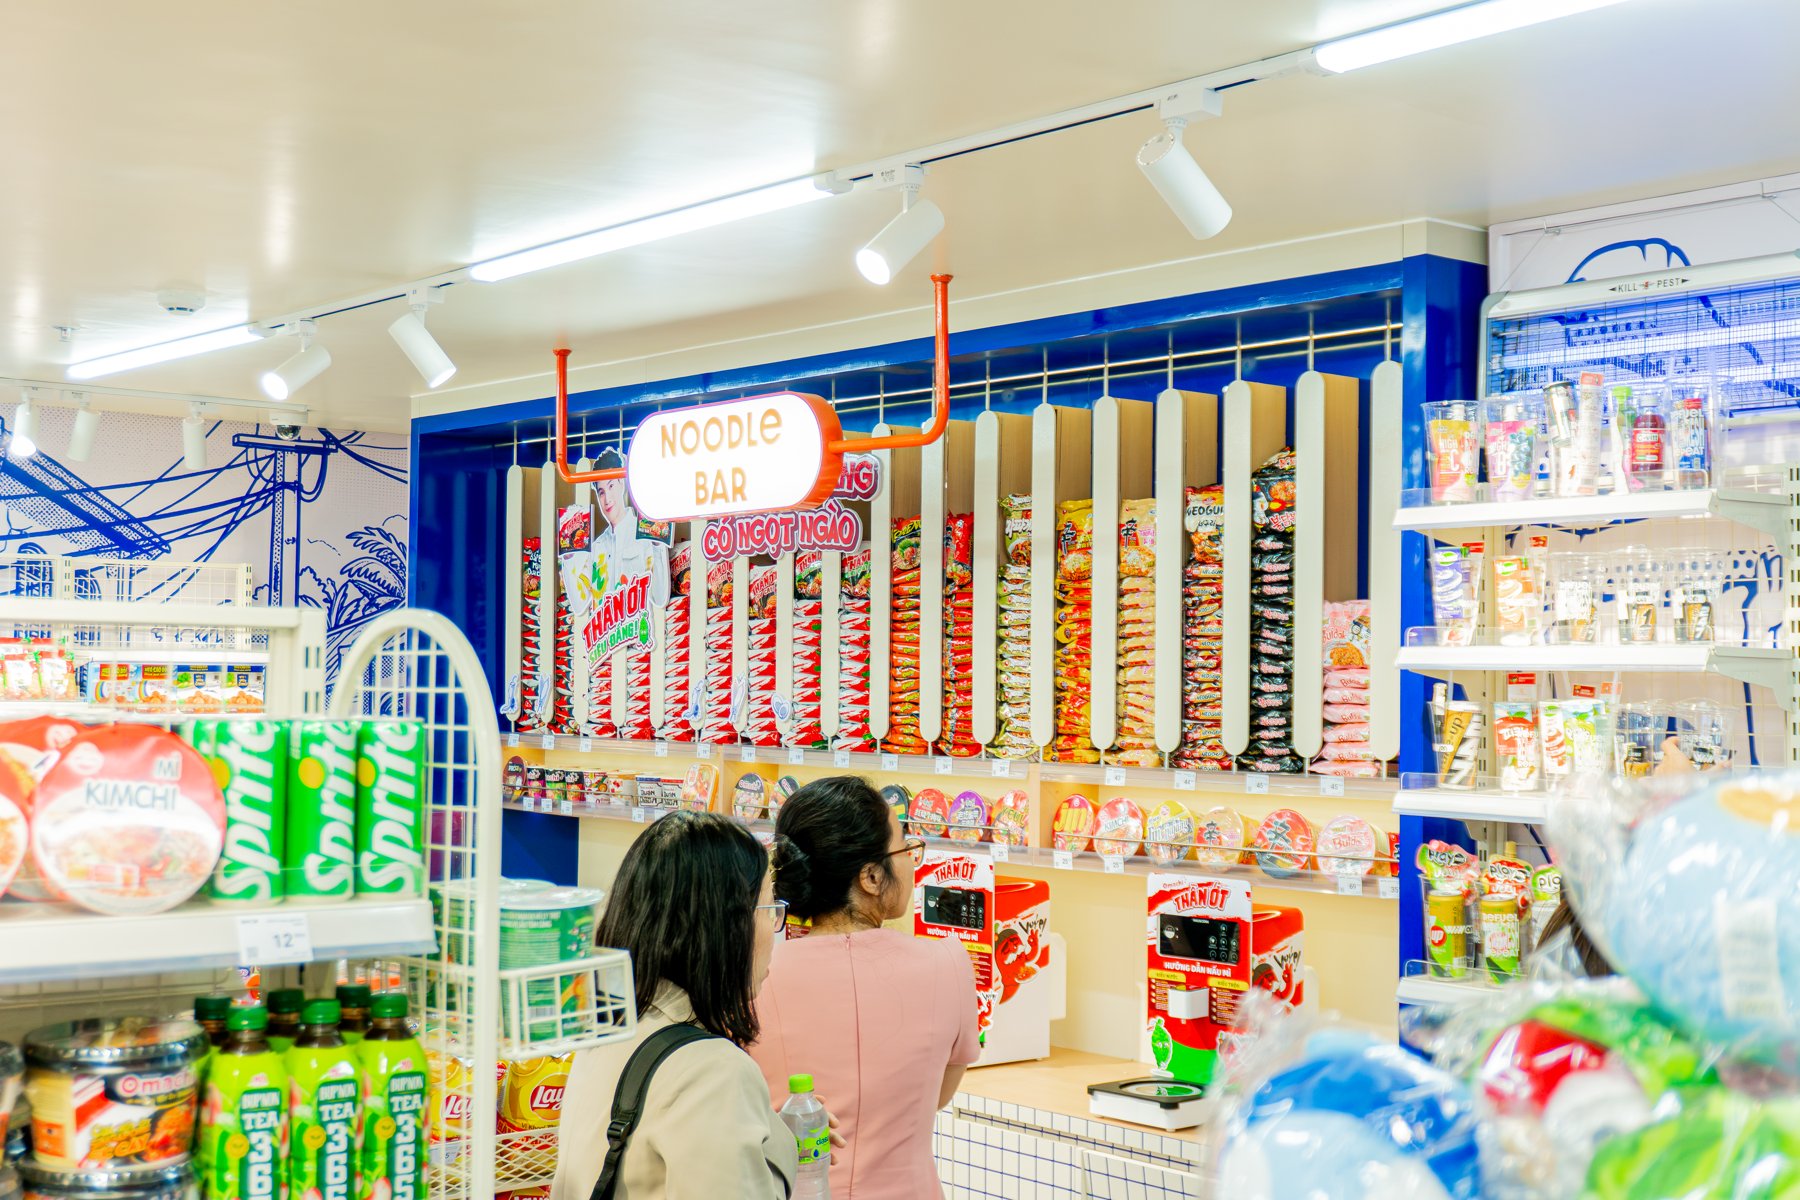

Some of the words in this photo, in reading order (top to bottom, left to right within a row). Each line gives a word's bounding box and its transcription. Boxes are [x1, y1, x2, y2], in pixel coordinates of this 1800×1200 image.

[1618, 283, 1638, 293] KILL
[1657, 278, 1681, 288] PEST
[695, 466, 748, 506] BAR
[704, 517, 732, 556] CÓ
[738, 517, 793, 553] NGỌT
[801, 503, 855, 546] NGÀO
[85, 783, 178, 811] KIMCHI
[303, 720, 357, 892] Sprite
[360, 720, 425, 900] Sprite
[214, 720, 281, 901] Sprite
[273, 933, 294, 949] 12
[119, 1071, 196, 1096] Omach
[318, 1101, 356, 1121] TEA
[391, 1093, 424, 1112] TEA
[531, 1086, 565, 1111] Lay
[242, 1111, 280, 1131] TEA
[247, 1130, 272, 1200] 36
